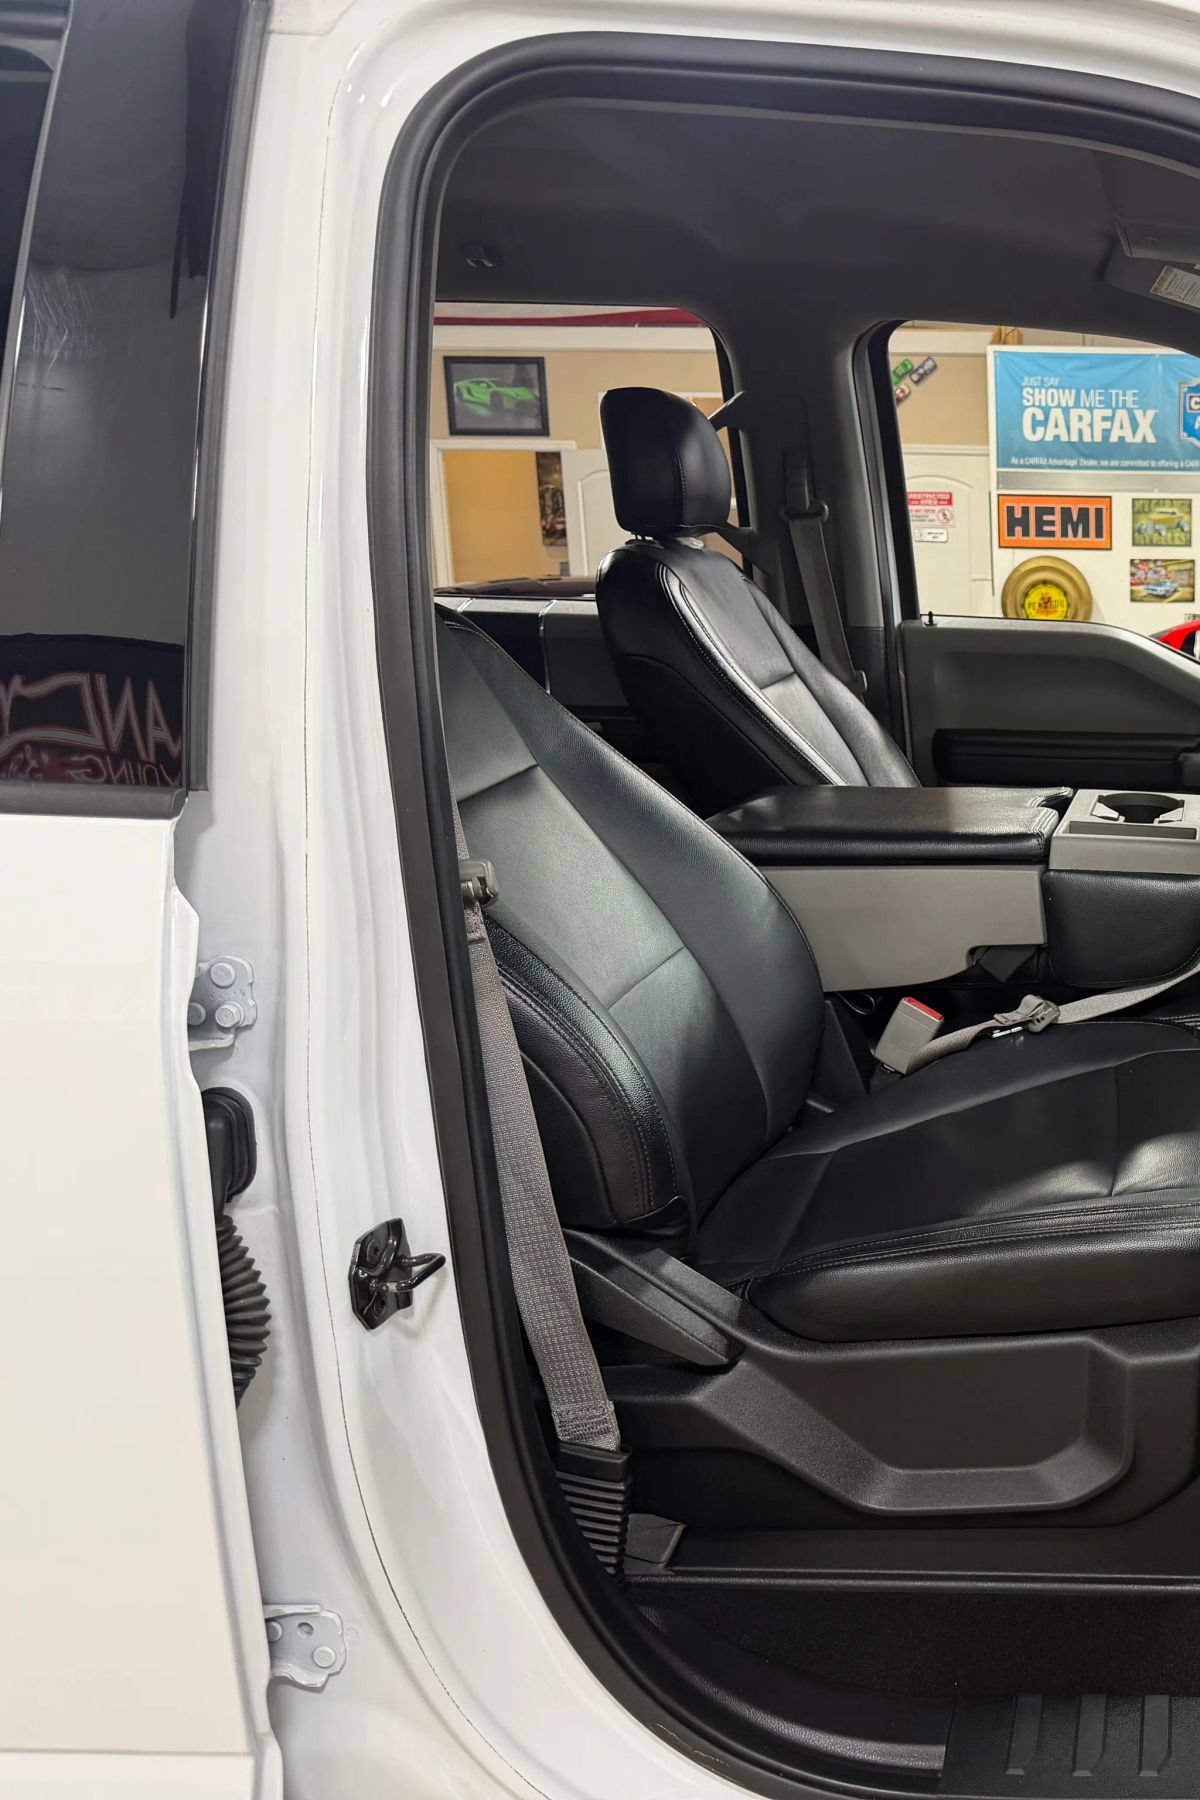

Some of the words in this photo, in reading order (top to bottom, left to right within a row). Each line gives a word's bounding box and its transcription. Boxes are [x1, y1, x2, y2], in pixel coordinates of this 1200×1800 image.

[1022, 377, 1040, 386] JUST
[1044, 377, 1060, 386] SAY
[1022, 388, 1076, 407] SHOW
[1080, 389, 1105, 408] ME
[1108, 389, 1139, 408] THE
[1022, 407, 1158, 443] CARFAX
[1006, 505, 1104, 539] HEMI
